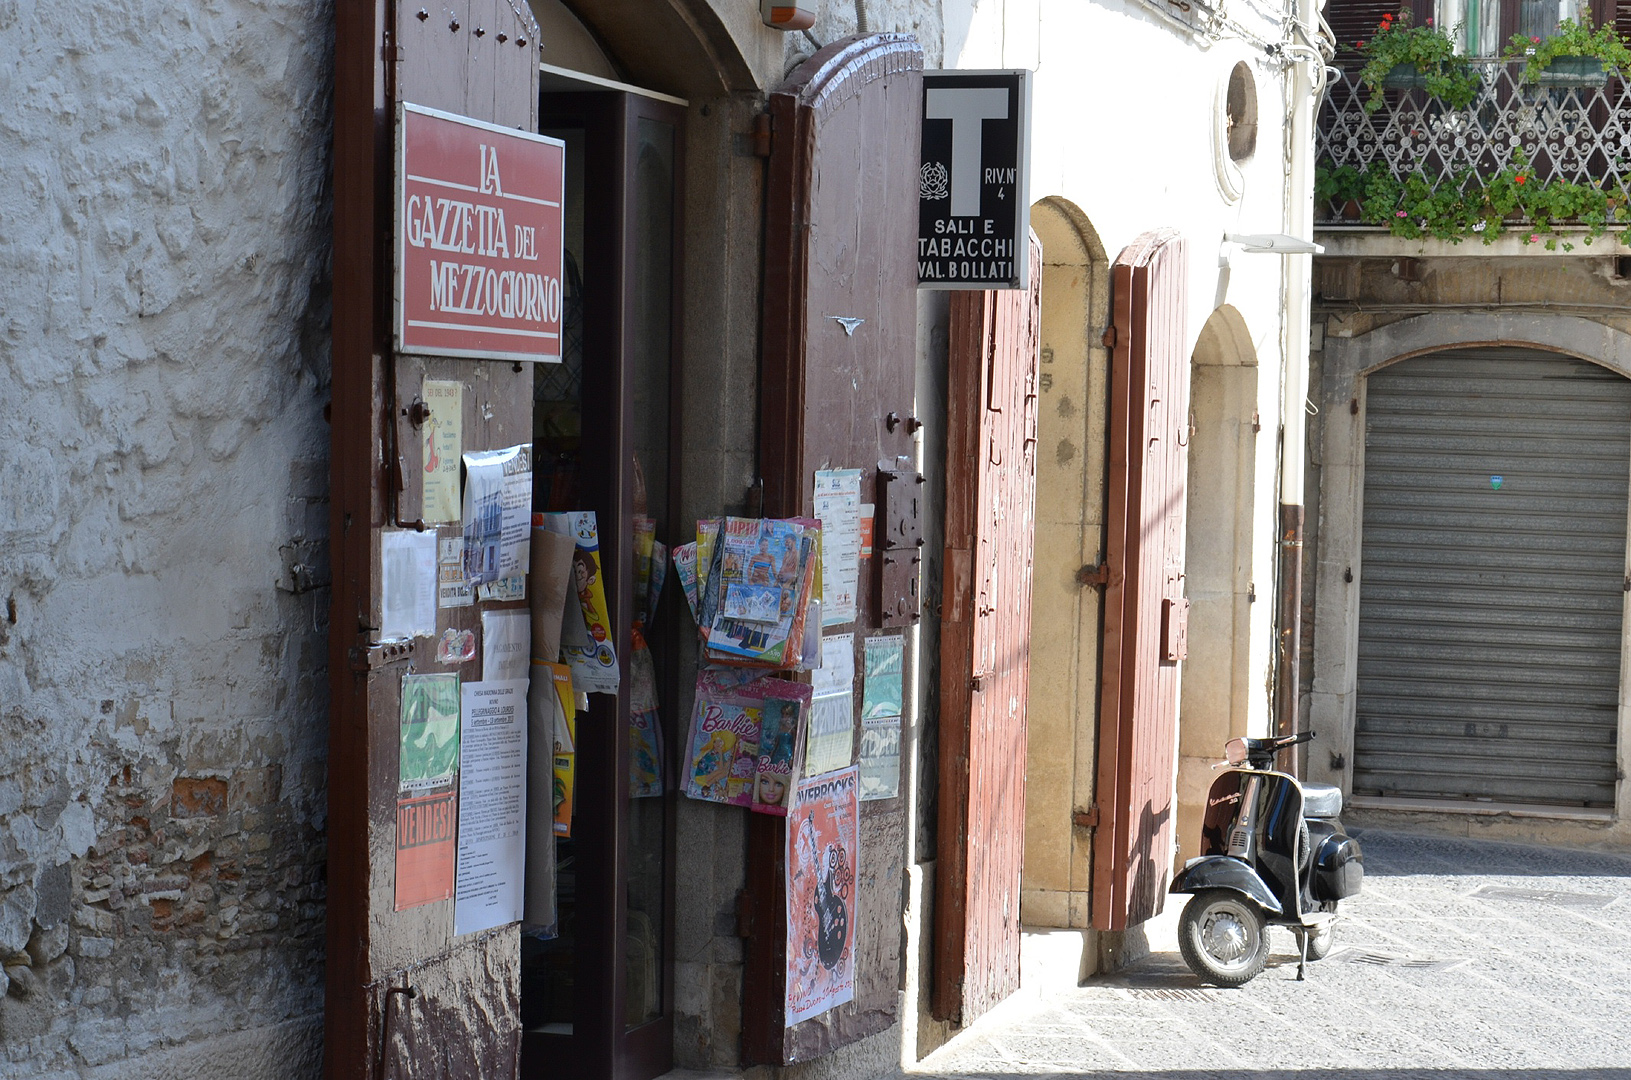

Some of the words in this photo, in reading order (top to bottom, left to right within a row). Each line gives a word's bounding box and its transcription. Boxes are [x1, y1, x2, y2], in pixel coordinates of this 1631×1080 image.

[926, 88, 1009, 216] T
[479, 144, 502, 197] LA
[997, 187, 1005, 200] 4
[407, 194, 509, 259] GAZZETTA
[514, 224, 538, 261] DEL
[934, 219, 974, 234] SALI
[984, 219, 994, 234] E
[918, 237, 1013, 257] TABACCHI
[918, 261, 945, 278] VAL.
[949, 261, 1012, 278] BOLLATI
[430, 260, 560, 323] MEZZOGIORNO
[702, 705, 759, 737] Barbie
[757, 755, 792, 776] Barbie
[401, 800, 452, 847] VENDESI
